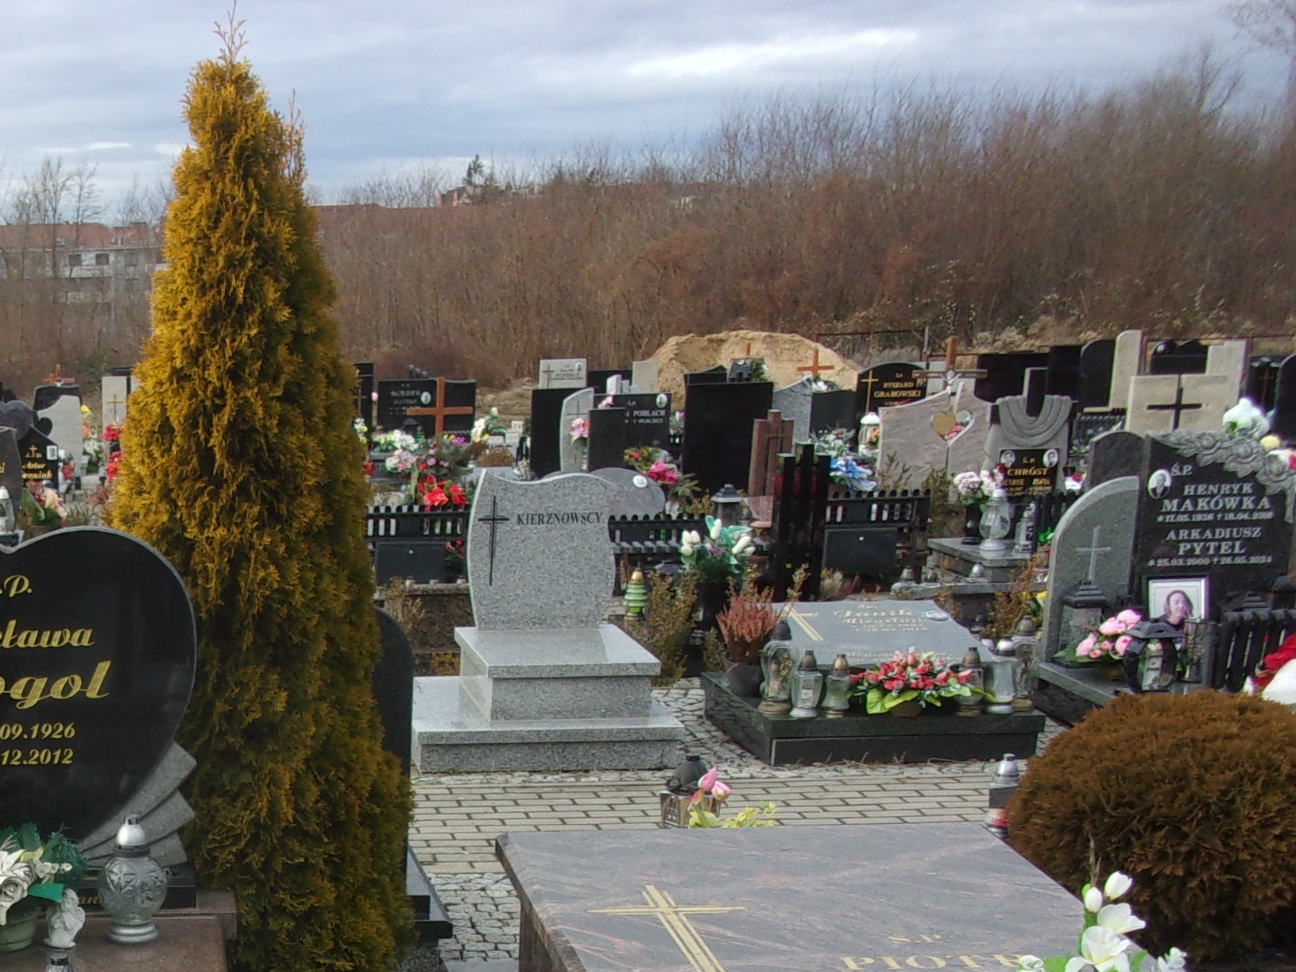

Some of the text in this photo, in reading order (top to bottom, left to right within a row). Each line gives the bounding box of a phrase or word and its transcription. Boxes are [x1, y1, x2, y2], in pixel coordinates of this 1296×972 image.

[1182, 483, 1254, 496] HENRYK
[1160, 495, 1272, 512] MAKÓWKA
[516, 512, 605, 526] KIERZNOWSCY
[1165, 527, 1264, 541] ARKADIUSZ
[1177, 540, 1247, 556] PYTEL
